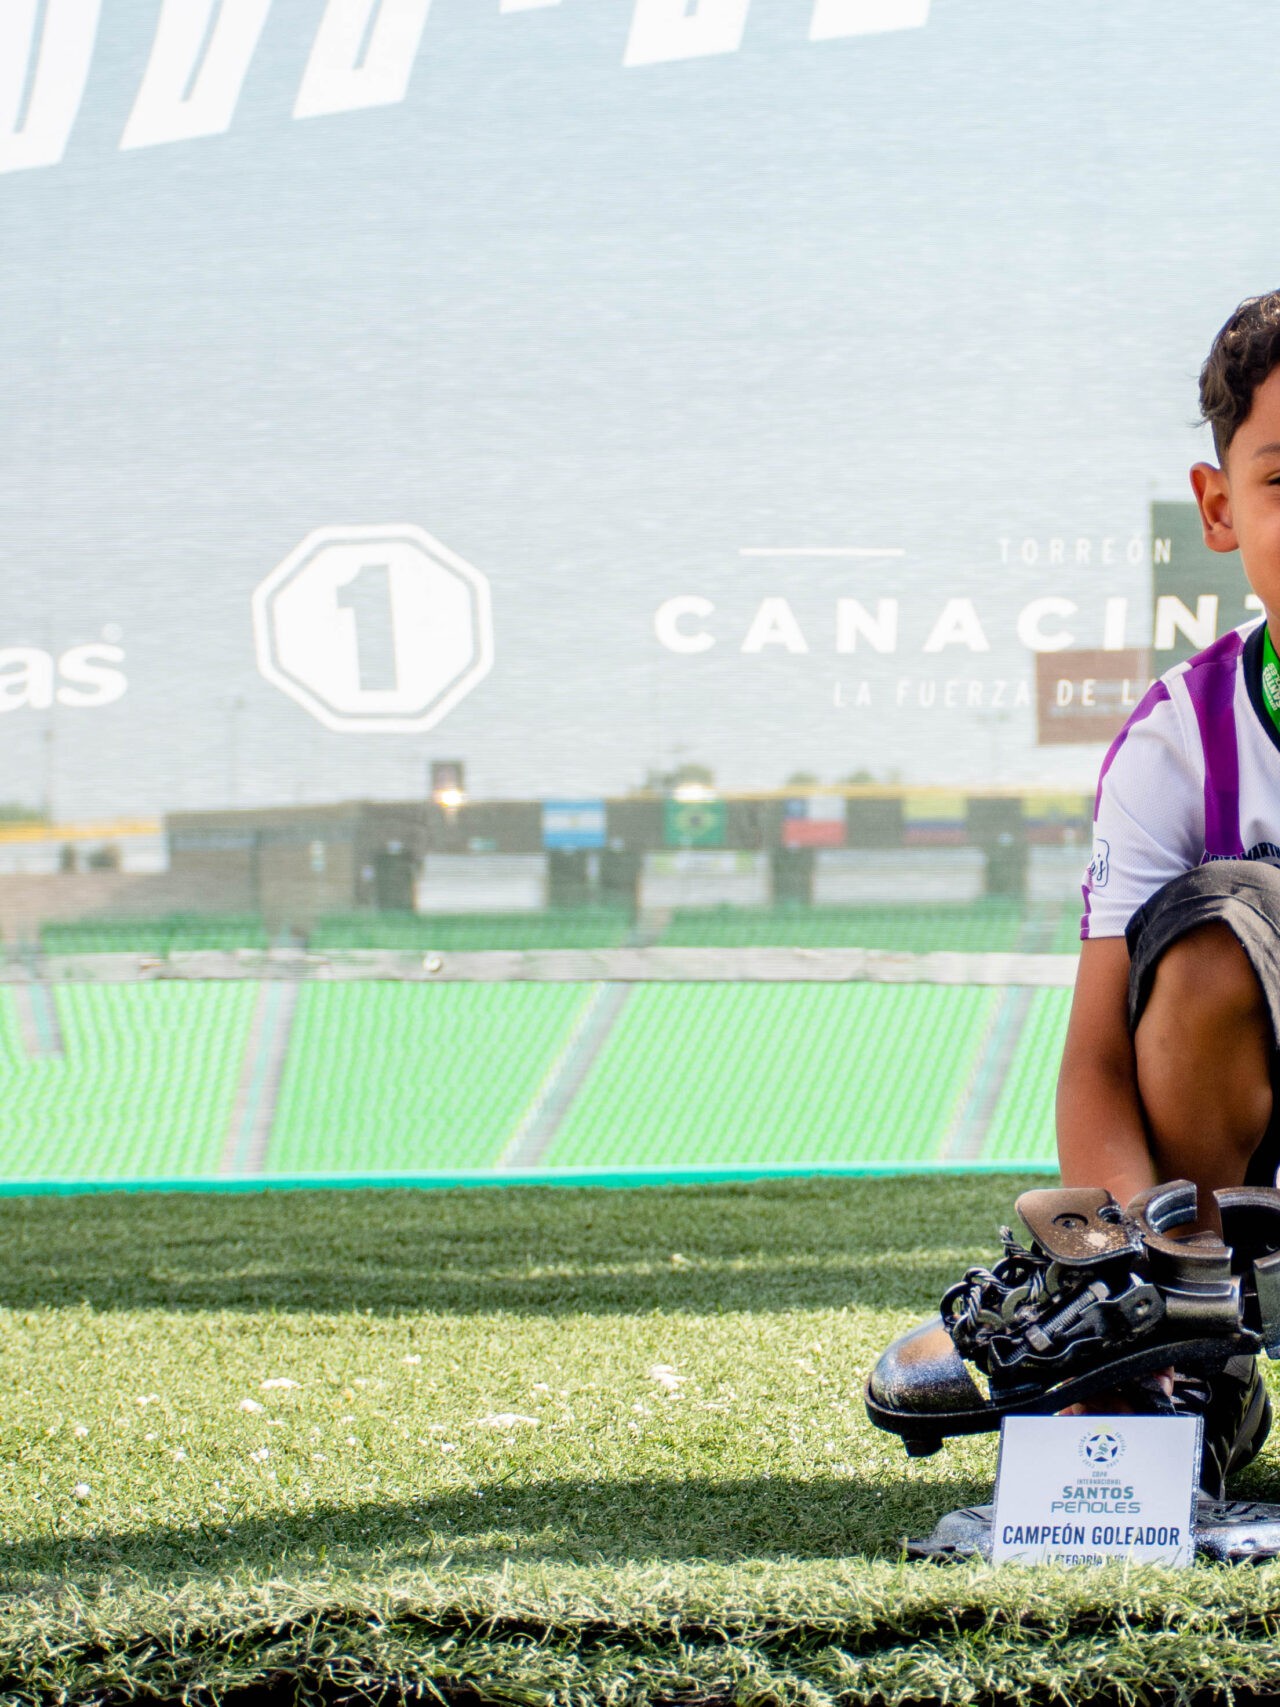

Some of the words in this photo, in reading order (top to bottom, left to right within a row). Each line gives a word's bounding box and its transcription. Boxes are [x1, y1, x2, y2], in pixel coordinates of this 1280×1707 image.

[1000, 532, 1172, 564] TORREÓN
[336, 563, 397, 692] 1
[653, 593, 1265, 653] CANACIN
[833, 679, 872, 708] LA
[898, 678, 1030, 708] FUERZA
[1056, 678, 1097, 707] DE
[1062, 1485, 1135, 1500] SANTOS
[1002, 1523, 1086, 1546] CAMPEÓN
[1091, 1526, 1180, 1547] GOLEADOR
